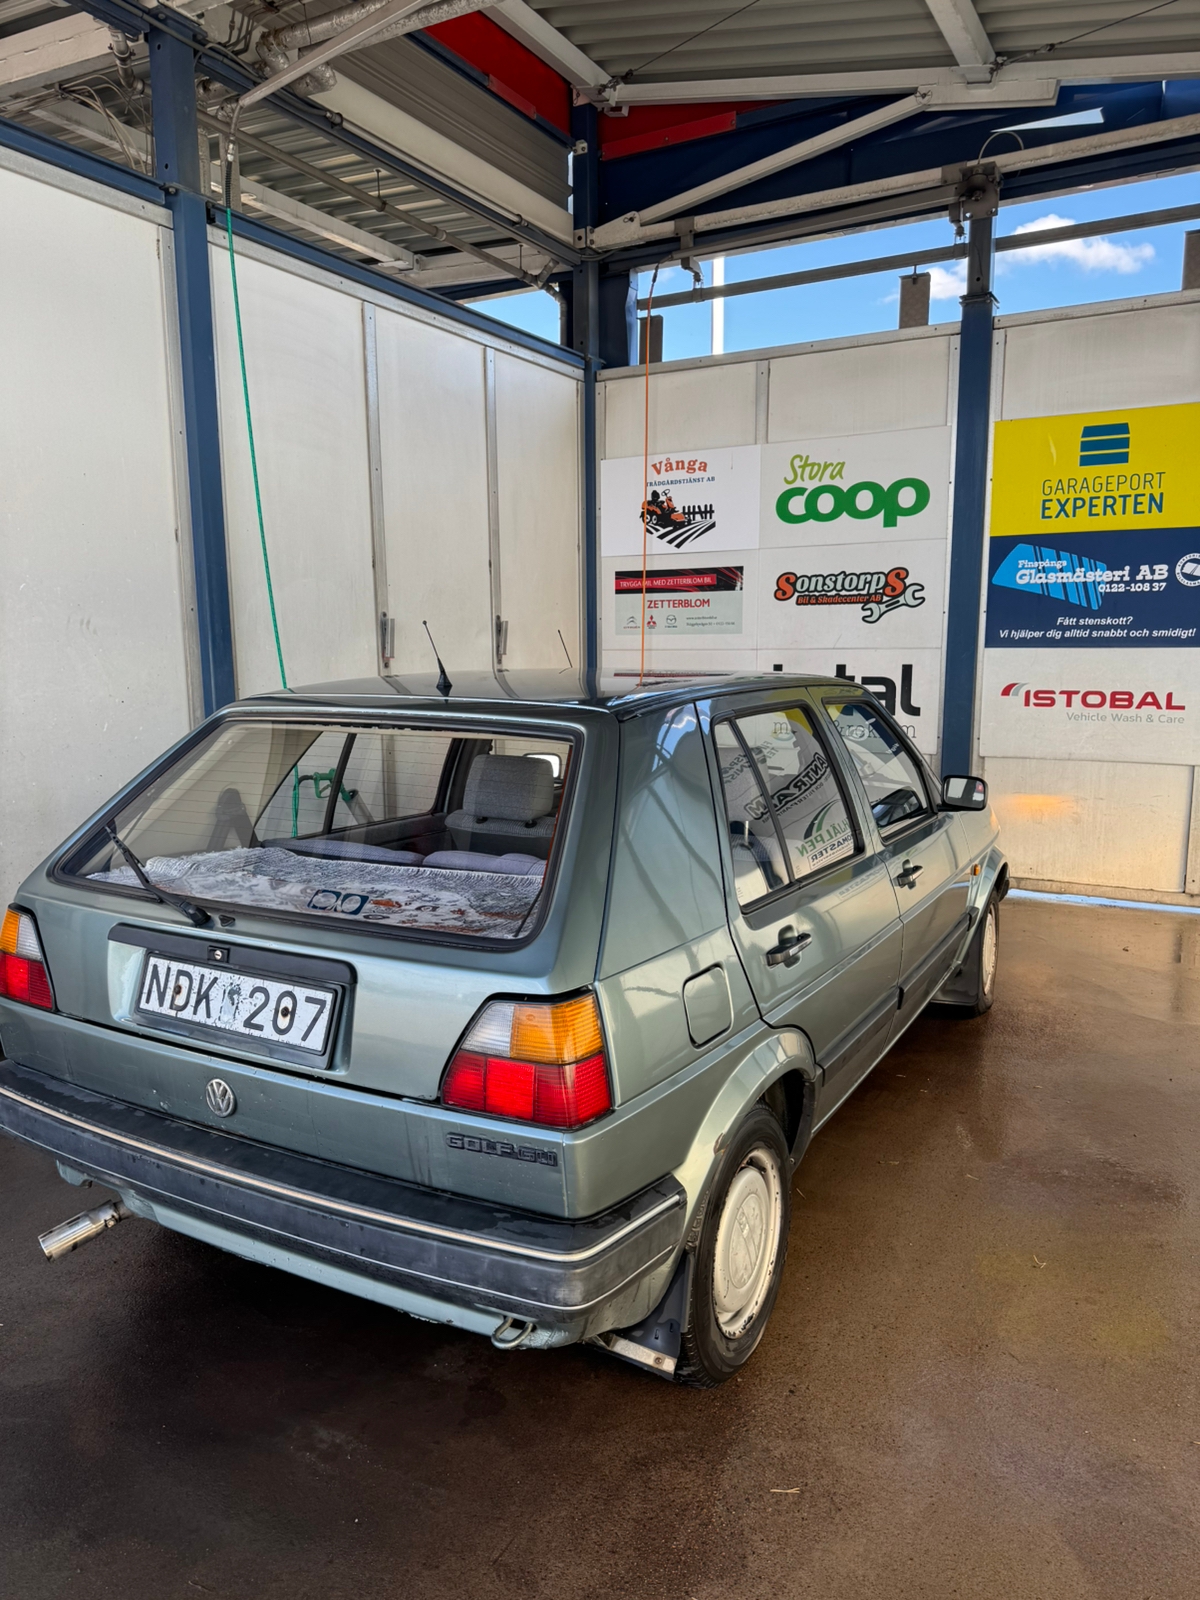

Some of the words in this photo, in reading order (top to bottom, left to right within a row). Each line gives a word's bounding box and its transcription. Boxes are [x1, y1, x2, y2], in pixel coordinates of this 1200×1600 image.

[651, 457, 708, 476] Vånga
[783, 454, 846, 485] Stora
[1041, 472, 1166, 496] GARAGEPORT
[775, 478, 931, 528] coop
[1041, 492, 1164, 520] EXPERTEN
[1016, 565, 1130, 584] Glasmästeri
[1136, 564, 1169, 581] AB
[1018, 560, 1067, 569] Finspångs
[1152, 582, 1167, 592] 37
[647, 598, 710, 609] ZETTERBLOM
[818, 594, 870, 604] Skadecenter
[1056, 616, 1077, 626] Fått
[1078, 616, 1134, 626] stenskott?
[999, 630, 1008, 638] Vi
[1010, 629, 1044, 639] hjälper
[1046, 628, 1062, 639] dig
[1064, 628, 1089, 638] alltid
[1091, 628, 1128, 638] snabbt
[1130, 628, 1149, 638] och
[1150, 628, 1196, 638] smidigt!
[1024, 690, 1186, 710] ISTOBAL
[1066, 712, 1107, 722] Vehicle
[1110, 712, 1144, 723] Wash
[1146, 714, 1154, 723] &
[1158, 714, 1186, 724] Care
[146, 963, 219, 1019] NDK
[242, 986, 328, 1042] 207
